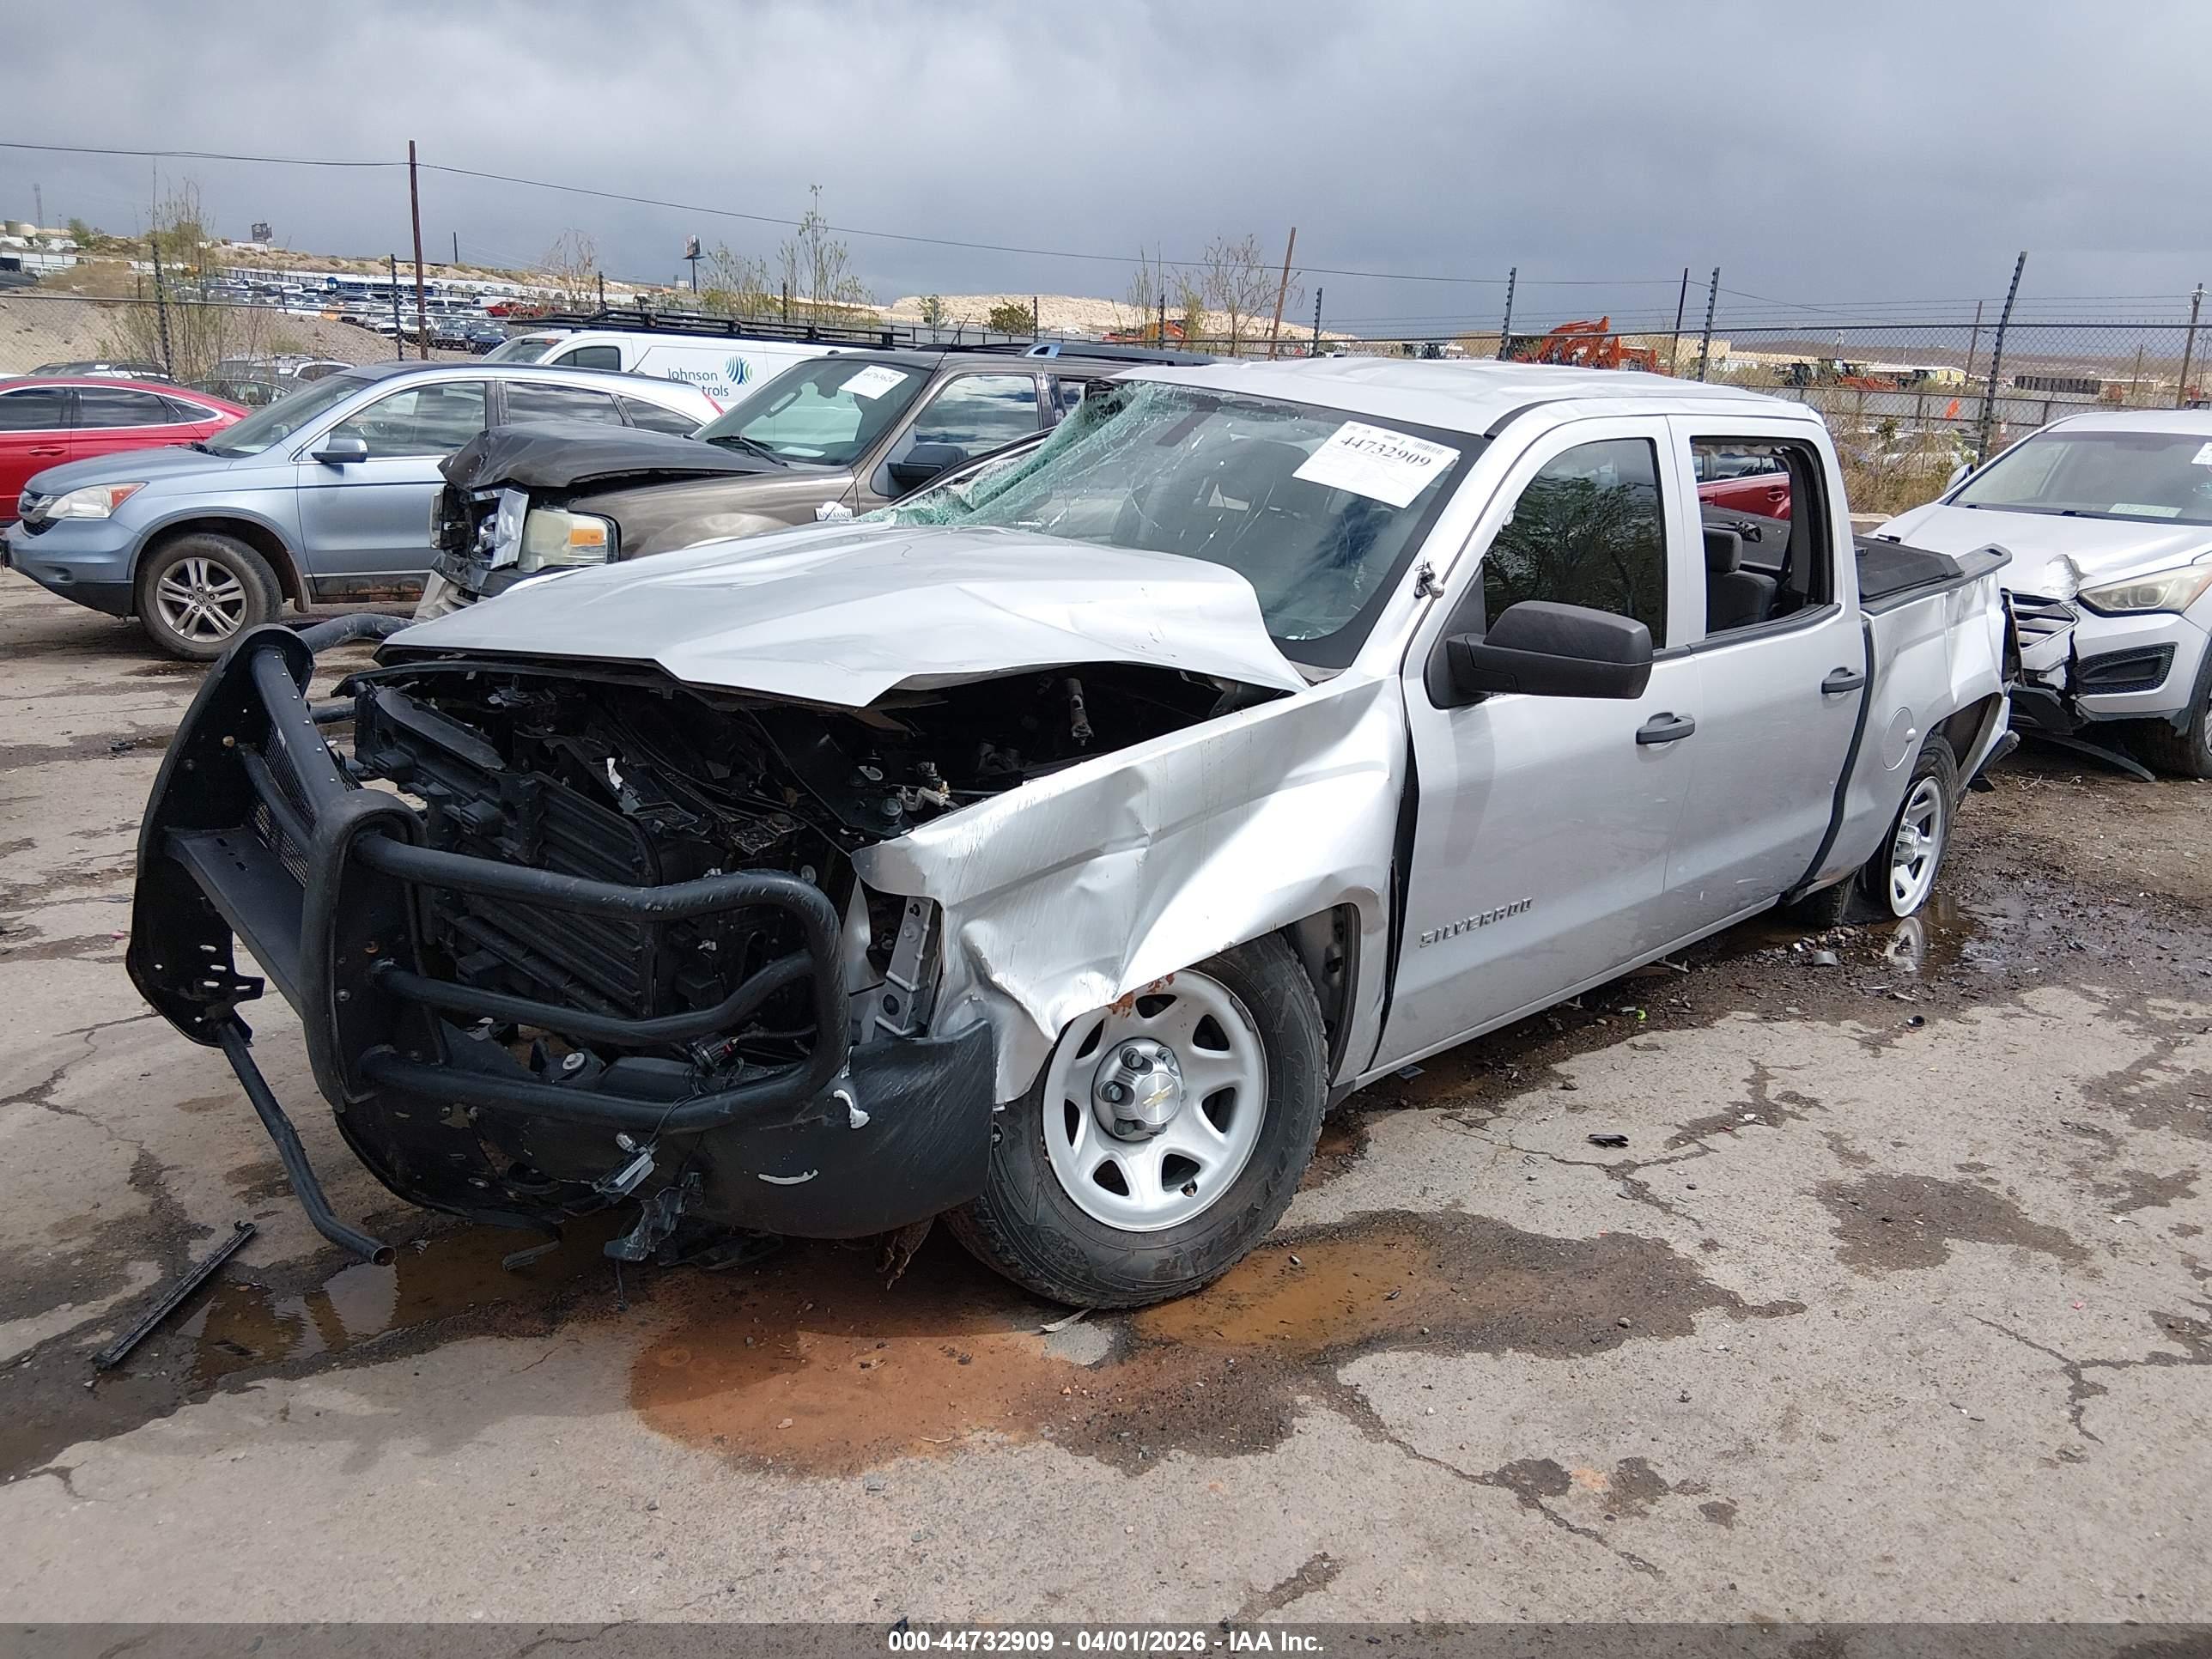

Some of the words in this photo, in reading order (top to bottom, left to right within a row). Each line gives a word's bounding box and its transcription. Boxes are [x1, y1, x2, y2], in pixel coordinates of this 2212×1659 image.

[667, 368, 718, 380] Johnson
[702, 385, 729, 396] trols
[1340, 436, 1431, 467] 44732909
[1419, 897, 1533, 948] SILVERADO
